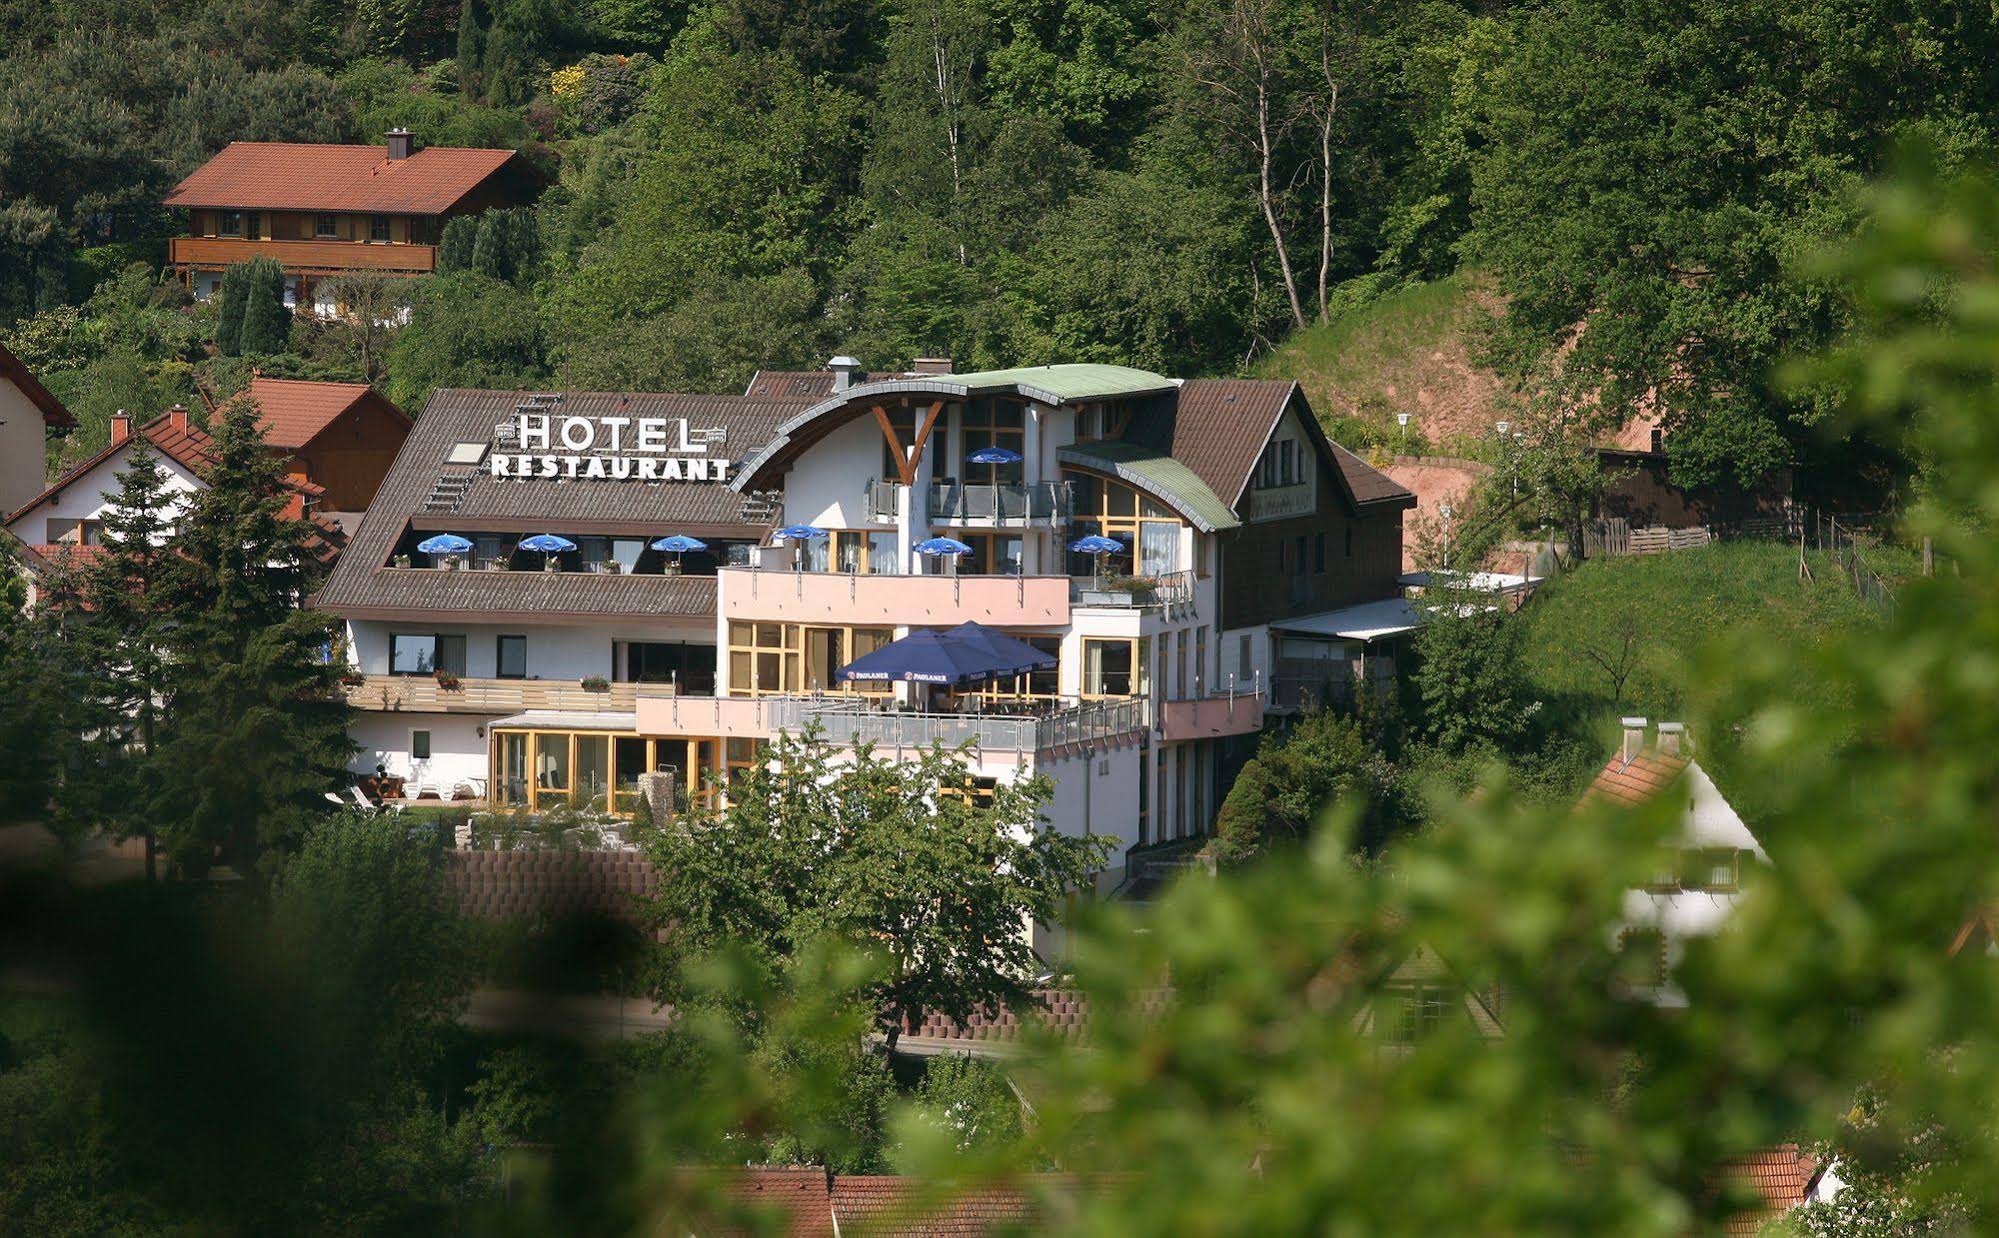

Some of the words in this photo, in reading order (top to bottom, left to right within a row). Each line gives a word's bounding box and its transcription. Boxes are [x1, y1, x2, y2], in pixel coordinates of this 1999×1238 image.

[520, 415, 708, 452] HOTEL
[491, 454, 730, 481] RESTAURANT
[856, 672, 889, 680] PAULANER
[913, 673, 947, 682] PAULANER
